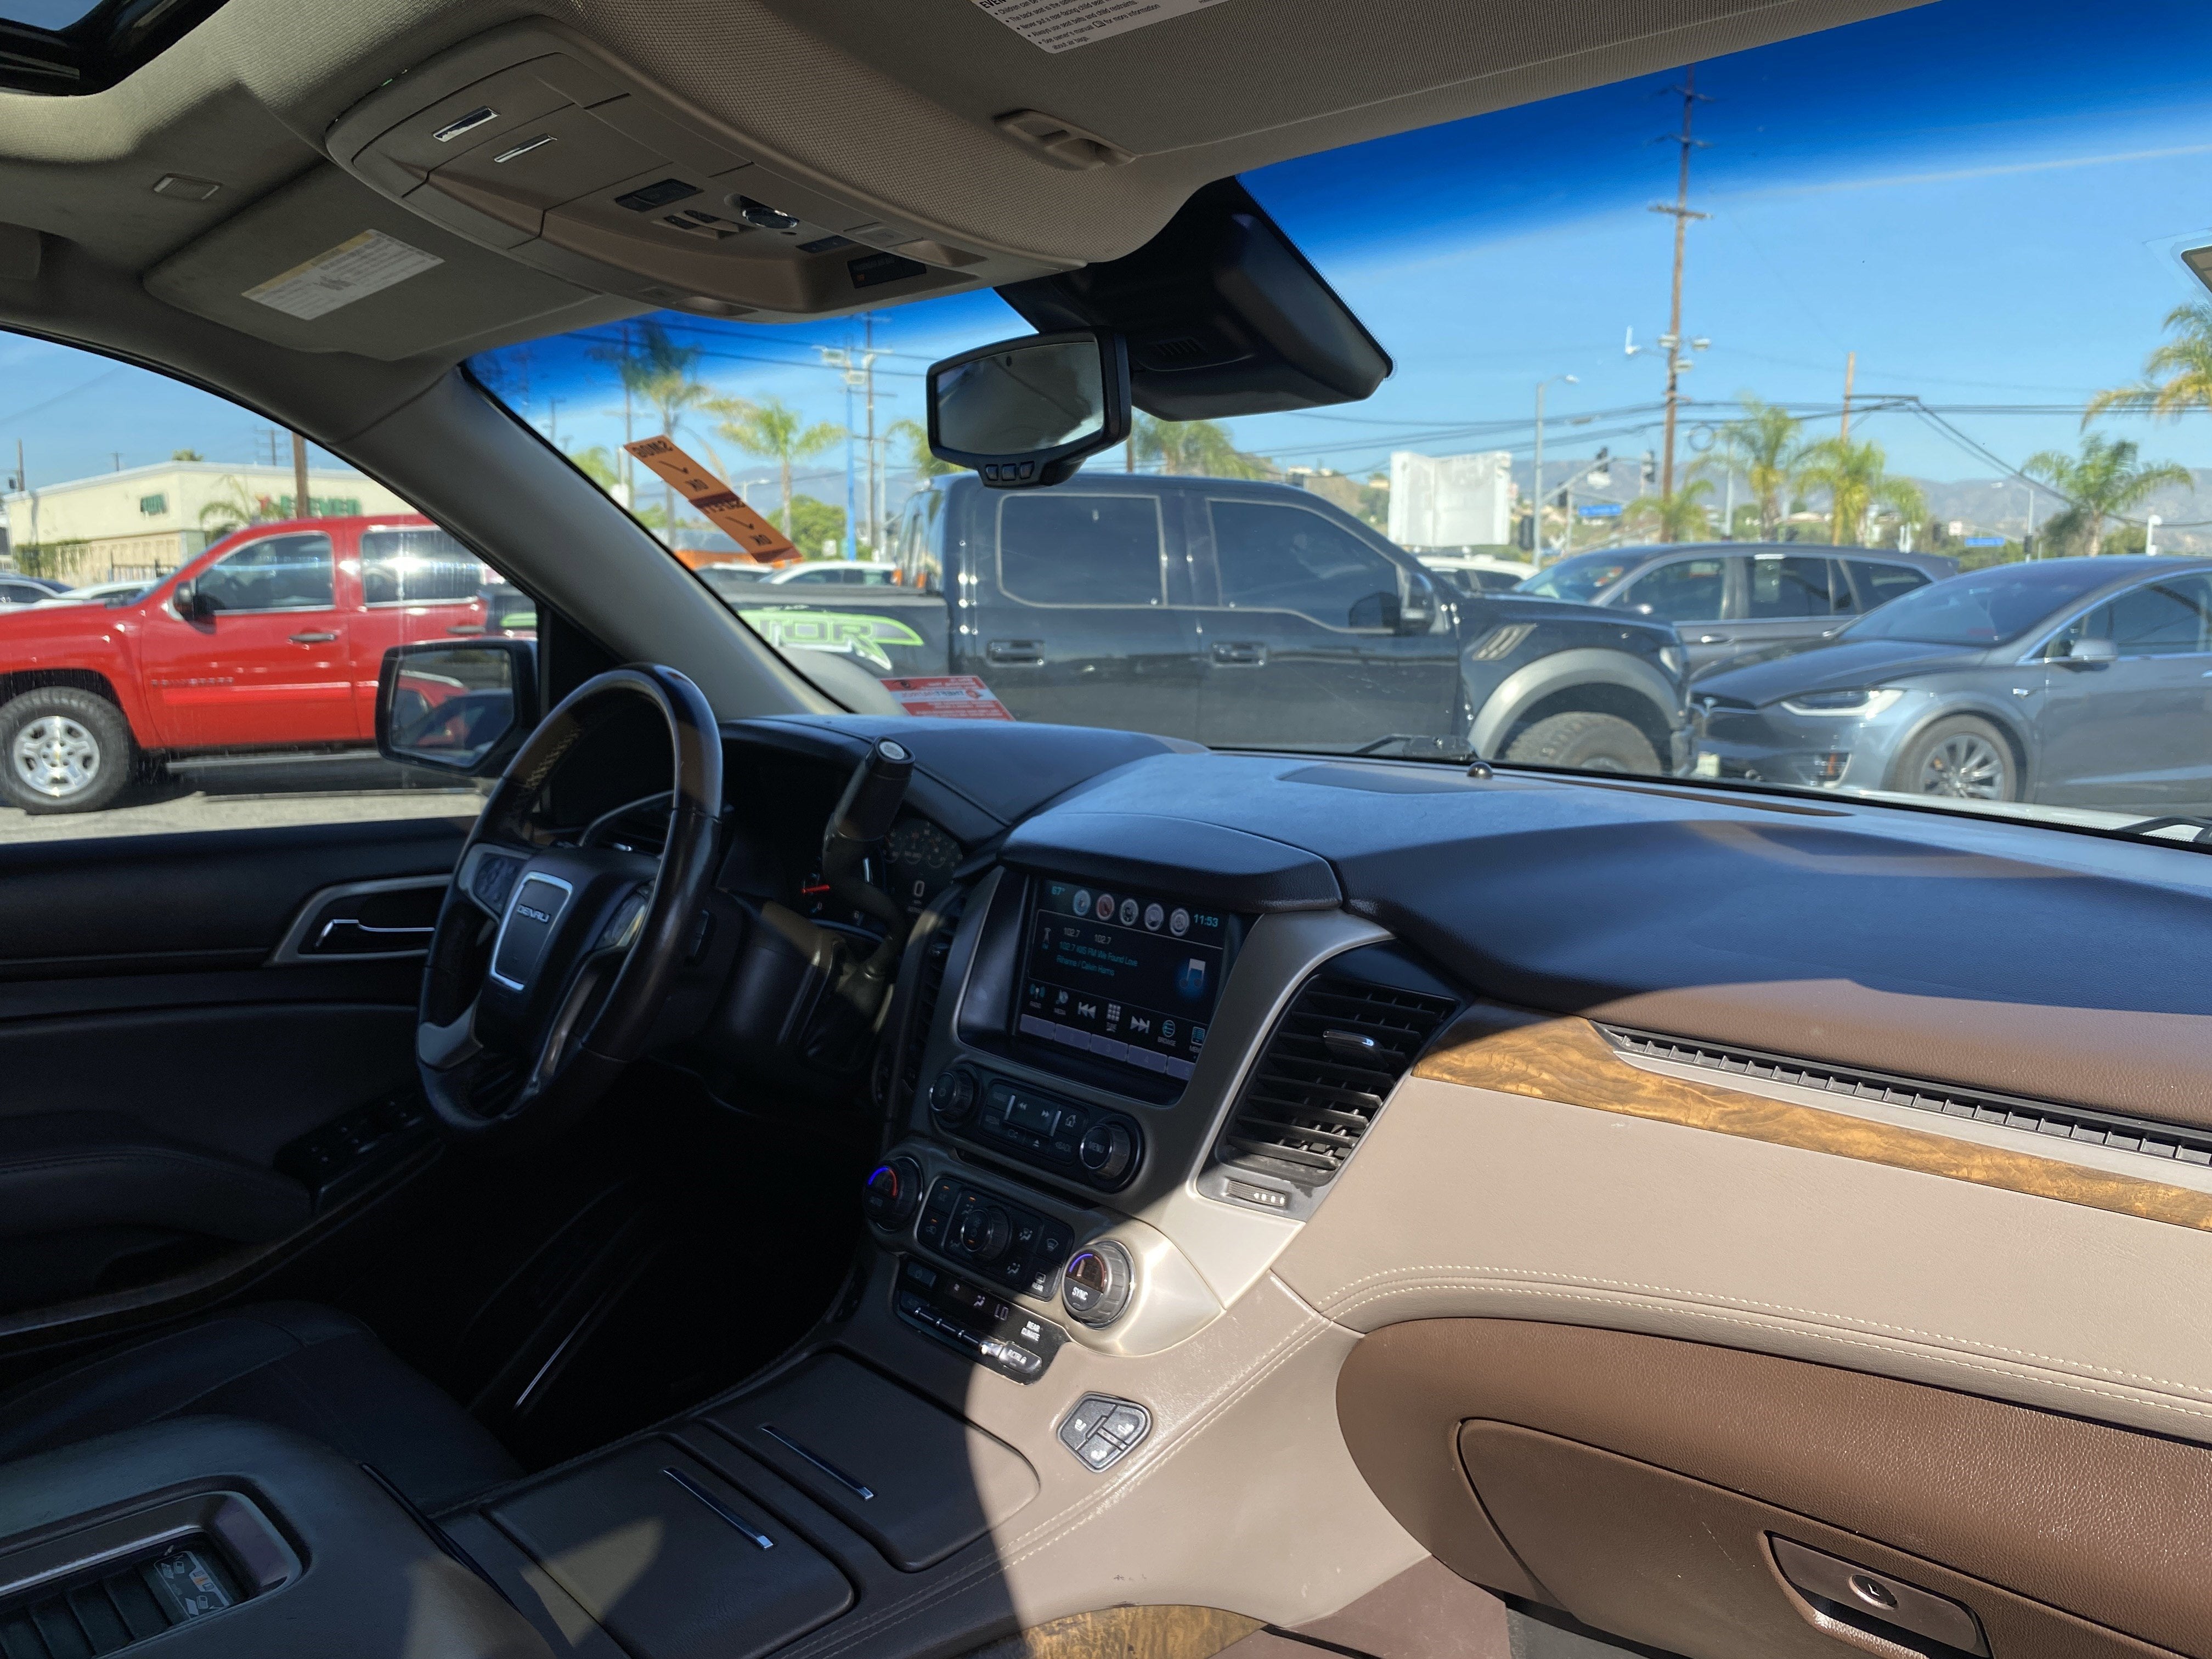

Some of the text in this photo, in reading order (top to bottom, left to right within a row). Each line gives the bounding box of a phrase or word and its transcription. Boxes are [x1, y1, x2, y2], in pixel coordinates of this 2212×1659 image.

[998, 4, 1021, 14] Children
[1021, 10, 1032, 19] back
[1051, 8, 1080, 20] rear-facing
[1077, 3, 1093, 12] child
[1031, 26, 1051, 37] Always
[1071, 16, 1087, 25] belts
[1096, 7, 1110, 16] child
[1053, 31, 1074, 41] owner's
[1074, 25, 1094, 33] manual
[1127, 3, 1161, 18] information
[1052, 42, 1068, 50] about
[280, 494, 362, 518] EEVEN
[913, 879, 926, 898] 0
[1193, 914, 1219, 928] 11:53
[1064, 927, 1081, 938] 102.7
[1094, 934, 1112, 945] 102.7
[1108, 952, 1125, 963] Found
[1125, 956, 1138, 967] Love
[1189, 1045, 1201, 1054] MEN
[1088, 1141, 1105, 1153] MENU
[1071, 1286, 1089, 1301] SYNC
[1026, 1321, 1041, 1333] REAR
